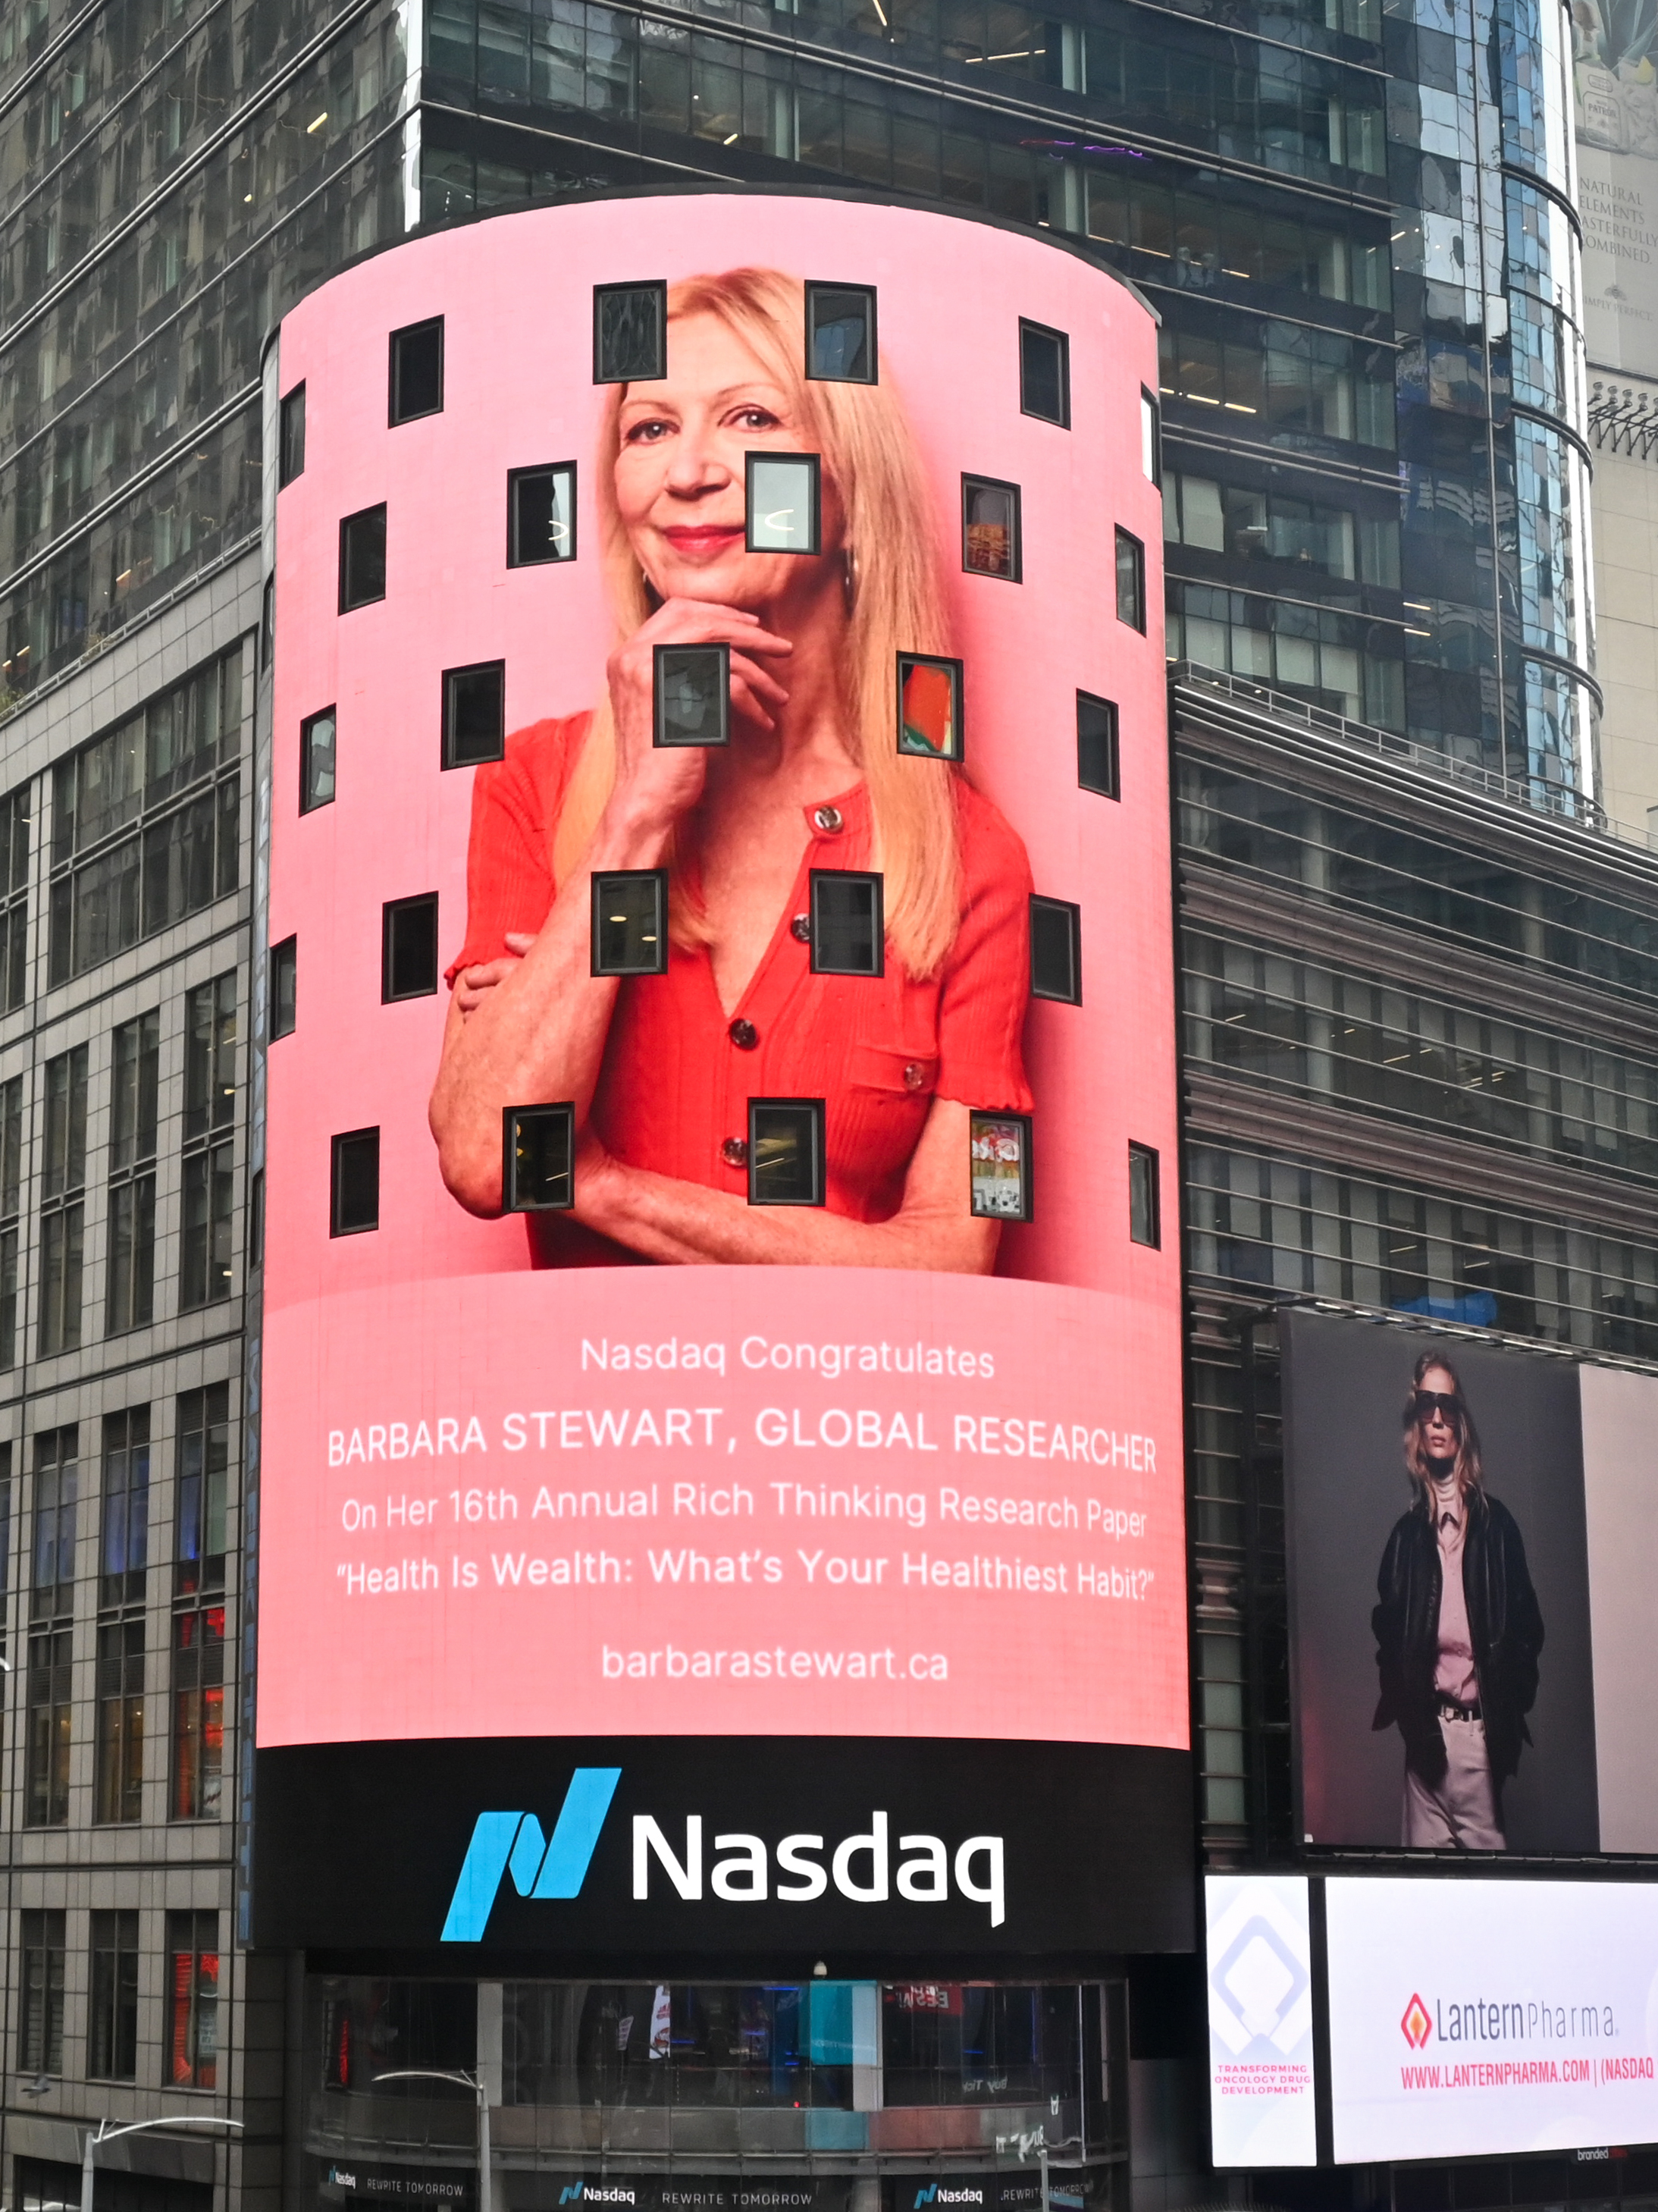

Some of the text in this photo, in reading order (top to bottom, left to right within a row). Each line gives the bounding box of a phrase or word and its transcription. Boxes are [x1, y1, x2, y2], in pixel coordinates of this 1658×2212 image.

[1579, 177, 1643, 206] NATURAL
[1579, 195, 1644, 225] ELEMENTS
[1582, 215, 1658, 247] ASTERFULLY
[1583, 295, 1610, 310] IMPLY
[581, 1335, 995, 1379] Nasdaq Congratulates
[328, 1407, 1157, 1473] BARBARA STEWART, GLOBAL RESEARCHER
[341, 1482, 1149, 1542] On Her 16th Annual Rich Thinking Research Paper
[336, 1548, 1155, 1602] “Health Is Wealth: What’s Your Healthiest Habit?”
[602, 1643, 948, 1681] barbarastewart.ca
[632, 1811, 1005, 1928] Nasdaq
[1215, 2076, 1311, 2084] ONCOLOGY DRUG
[1218, 2065, 1307, 2073] TRANSFORMING
[1401, 2060, 1590, 2089] WWW.LANTERNPHARMA.COM
[1601, 2056, 1654, 2085] (NASDAQ
[1221, 2086, 1305, 2094] DEVELOPMENT
[335, 2172, 356, 2189] Nasdaq
[406, 2182, 463, 2196] TOMORROW
[583, 2188, 812, 2205] Nasdaq REWRITE TOMORROW
[937, 2188, 983, 2204] Nasdaq
